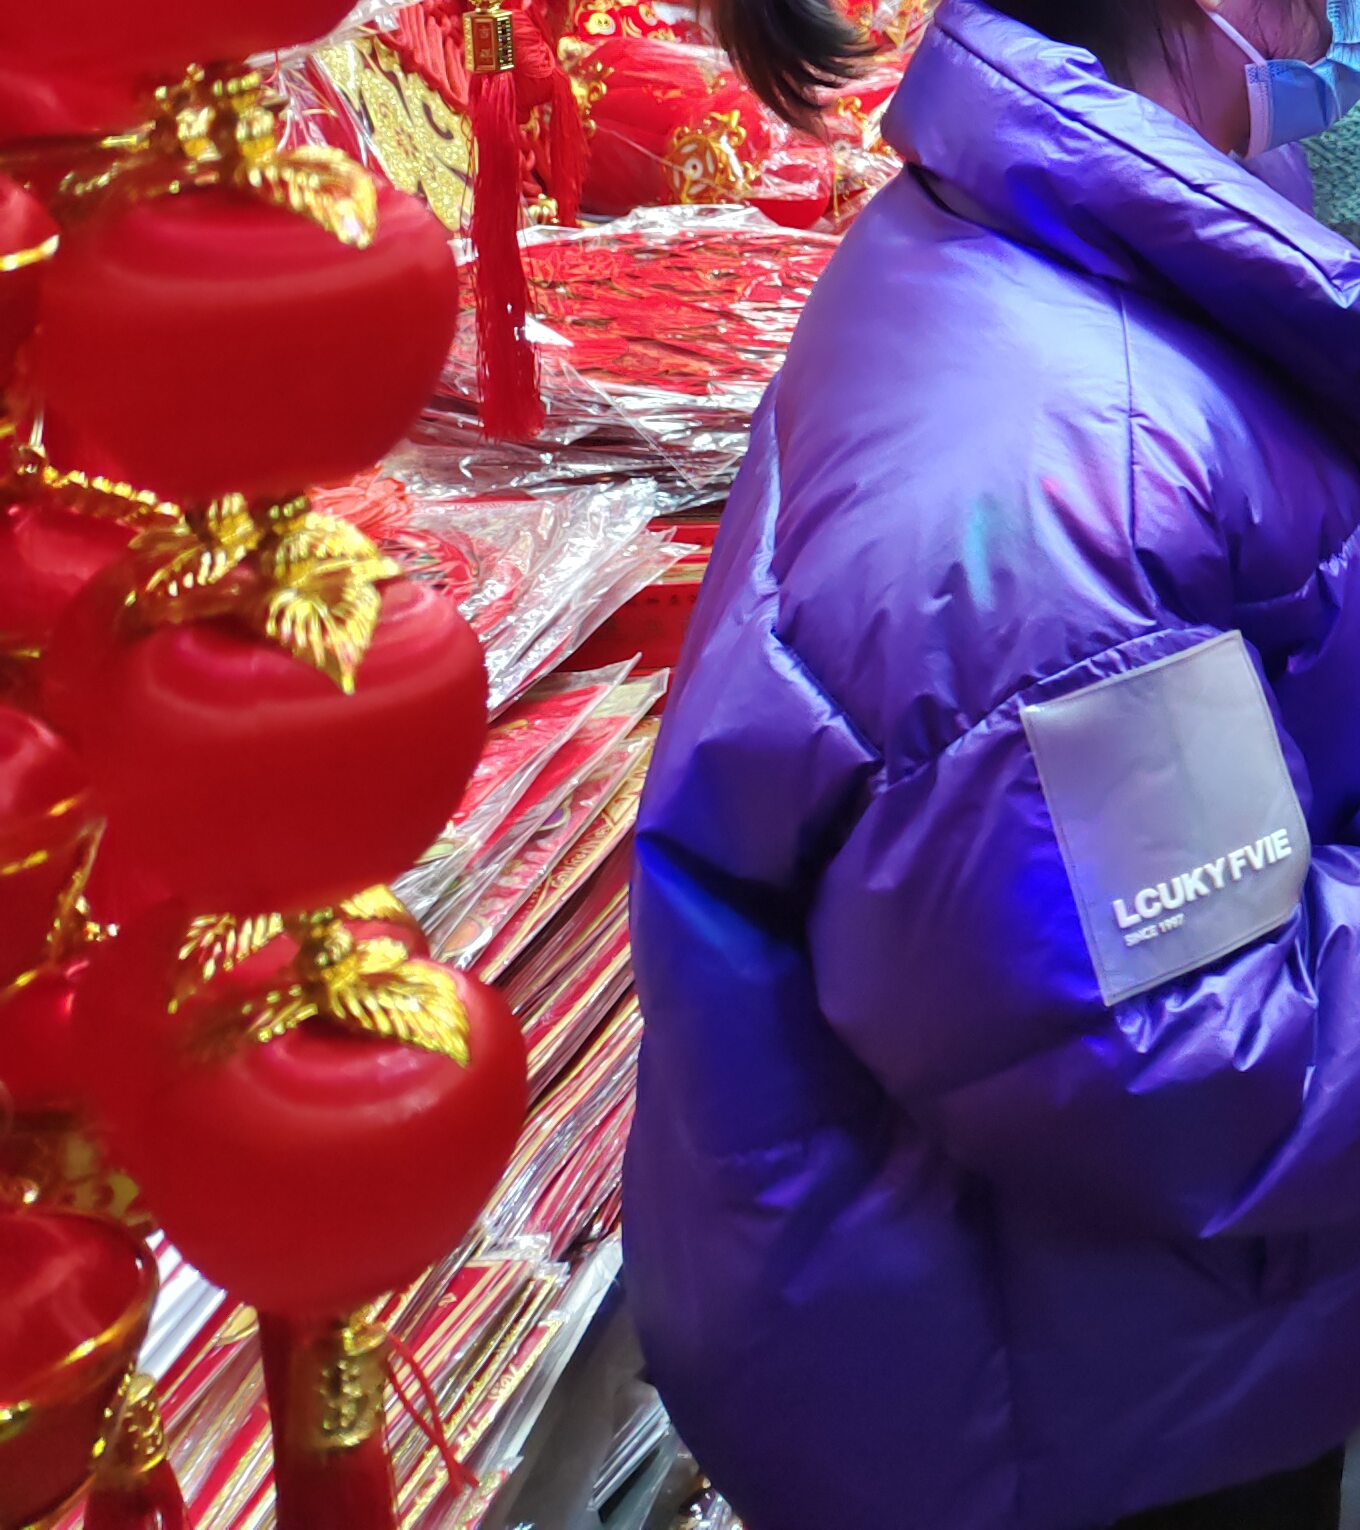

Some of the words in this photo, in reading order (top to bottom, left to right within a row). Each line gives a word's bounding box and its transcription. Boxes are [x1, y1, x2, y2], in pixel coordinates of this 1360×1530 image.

[1112, 857, 1227, 929] LCUKY
[1228, 828, 1293, 881] FVIE
[1124, 925, 1159, 948] SINCE
[1158, 913, 1185, 934] 1997
